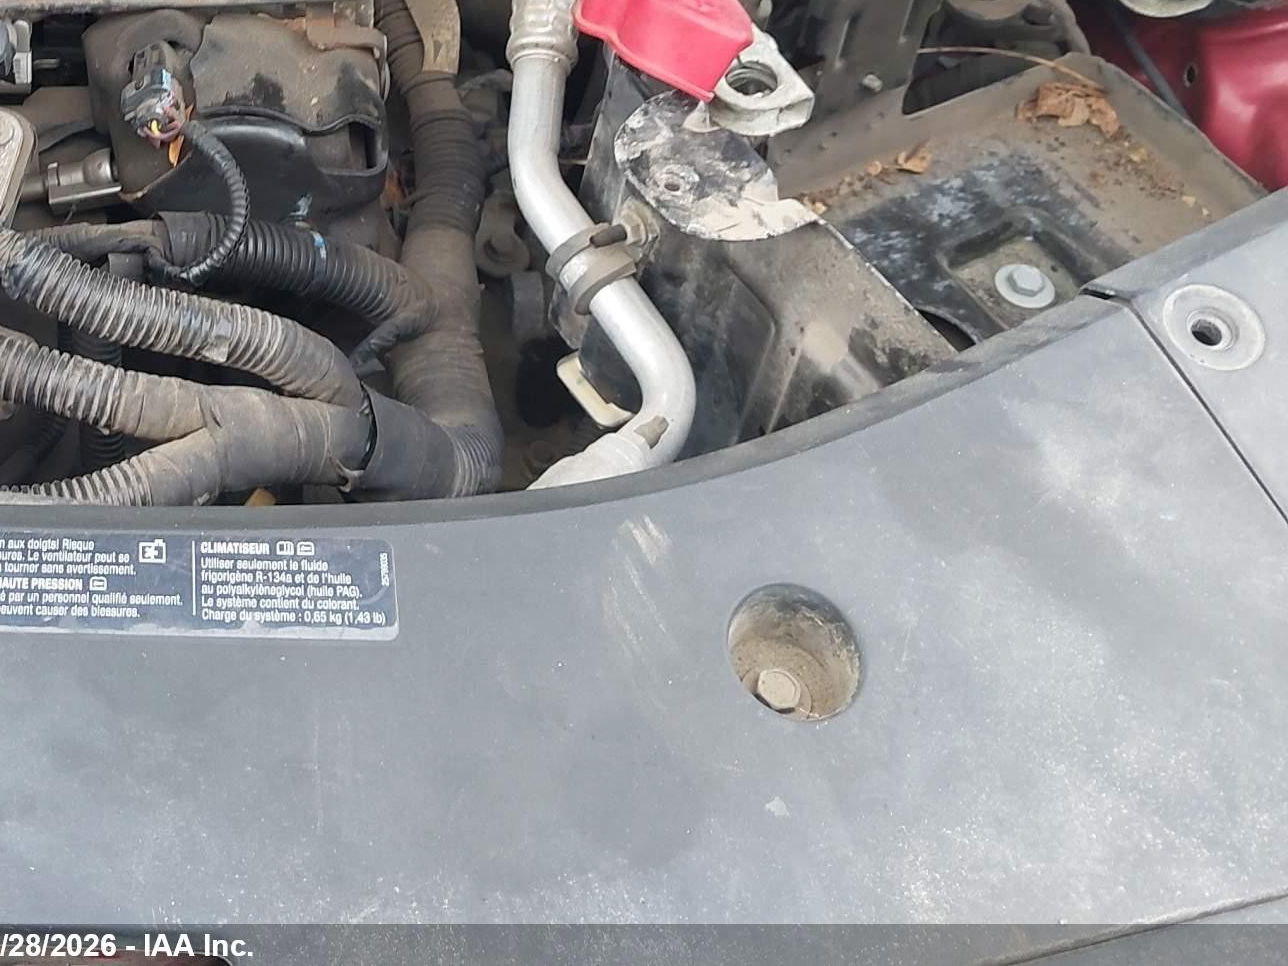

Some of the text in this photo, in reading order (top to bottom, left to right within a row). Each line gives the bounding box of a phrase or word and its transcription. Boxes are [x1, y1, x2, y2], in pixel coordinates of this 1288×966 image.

[8, 539, 25, 550] aux
[63, 539, 94, 552] Risque
[201, 542, 270, 554] CLIMATISEUR
[27, 550, 39, 560] Le
[43, 551, 91, 563] ventilateur
[94, 552, 115, 564] peut
[118, 553, 130, 563] se
[5, 563, 39, 573] tourner
[42, 564, 61, 573] sans
[66, 563, 136, 575] avertissement.
[201, 559, 328, 570] Utiliser seulement le fluide
[32, 578, 82, 590] PRESSION
[201, 571, 253, 583] frigorigène
[255, 572, 292, 583] R-134a
[295, 573, 304, 583] et
[307, 573, 319, 584] de
[202, 585, 362, 598] au polyalkylèneglycol (huile PAG).
[9, 591, 25, 604] par
[28, 592, 39, 602] un
[42, 592, 88, 605] personnel
[92, 593, 126, 606] qualifié
[130, 595, 183, 606] seulement.
[202, 597, 359, 610] Le système contient du colorant.
[36, 605, 68, 616] causer
[71, 605, 88, 616] des
[91, 606, 140, 618] blessures.
[202, 609, 236, 622] Charge
[240, 610, 252, 621] du
[255, 611, 296, 622] système
[304, 612, 327, 623] 0,65
[329, 613, 342, 625] kg
[345, 612, 370, 625] (1,43
[373, 613, 386, 625] lb)
